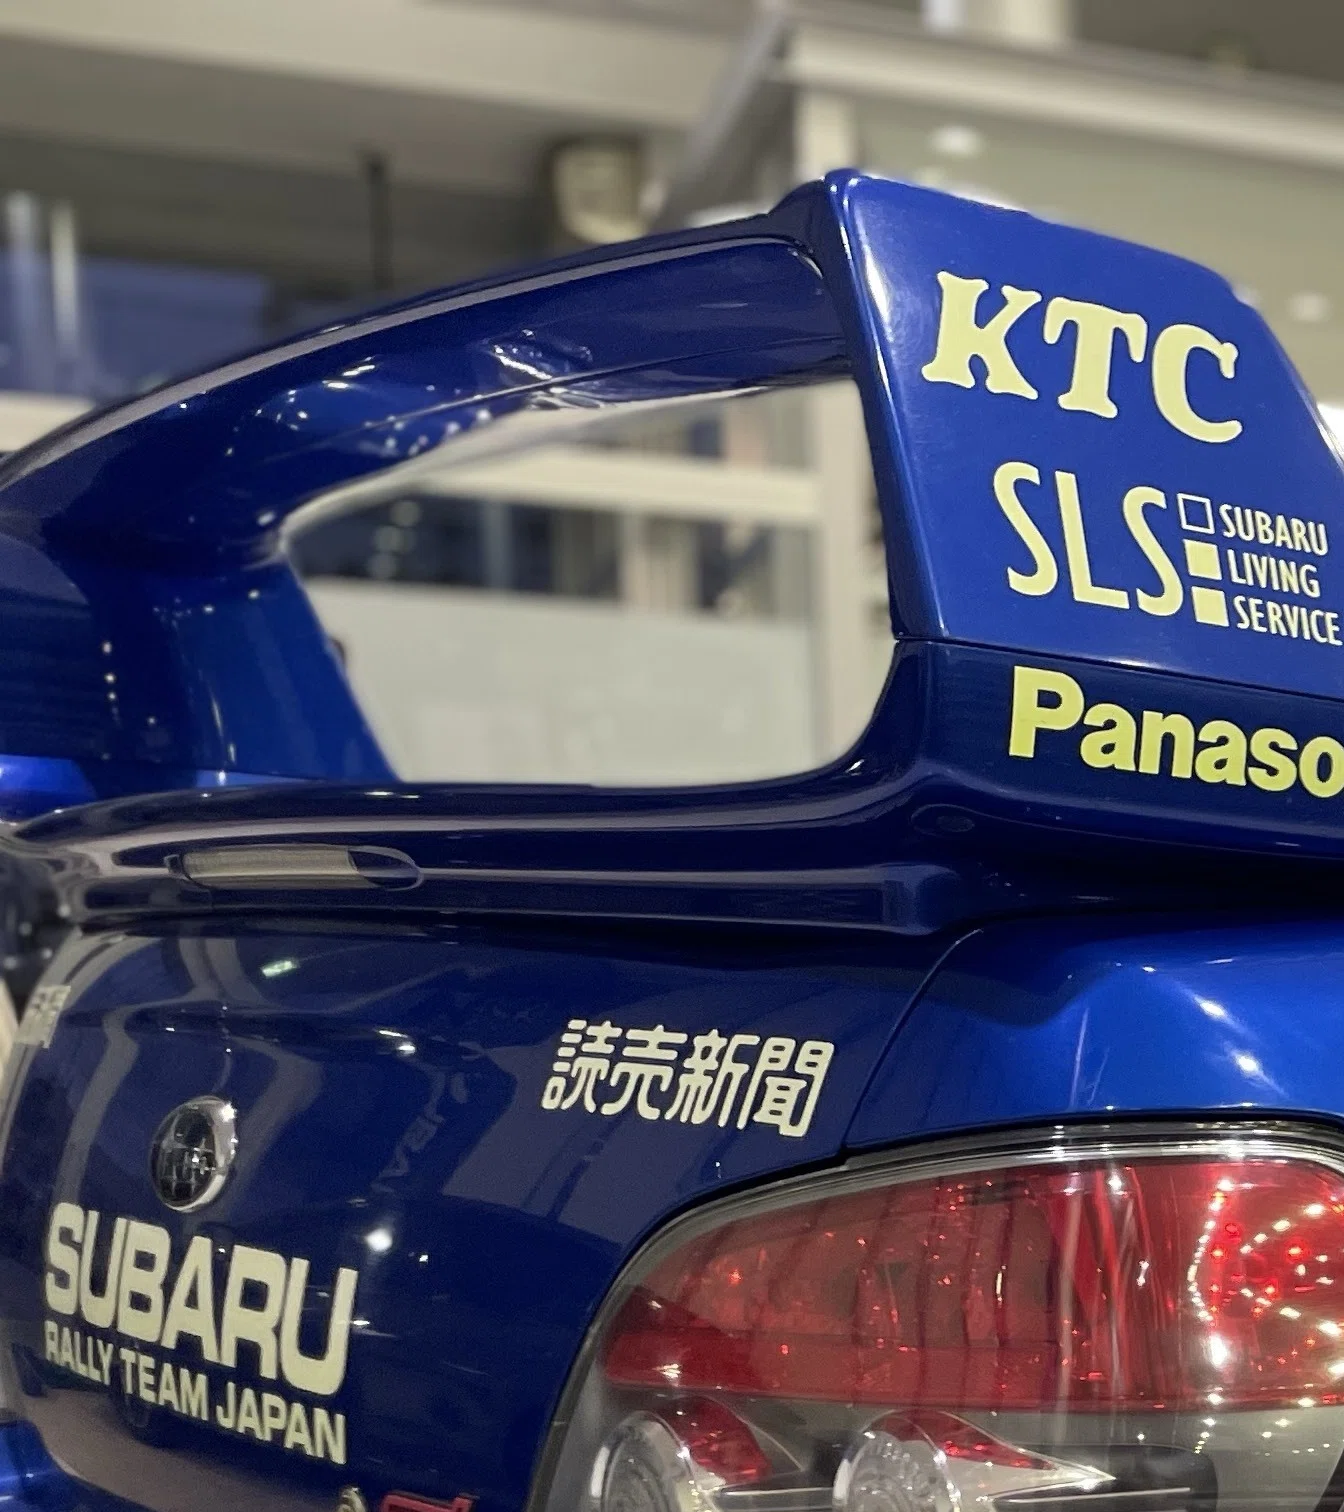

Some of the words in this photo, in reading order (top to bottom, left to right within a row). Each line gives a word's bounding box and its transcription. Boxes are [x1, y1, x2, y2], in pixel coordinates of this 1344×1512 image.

[922, 271, 1243, 442] KTC
[993, 461, 1184, 617] SLS
[1220, 504, 1328, 556] SUBARU
[1227, 550, 1320, 598] LIVING
[1233, 596, 1343, 646] SERVICE
[541, 1019, 835, 1137] 読売新聞
[45, 1202, 358, 1396] SUBARU
[45, 1320, 115, 1386] RALLY
[120, 1348, 208, 1421] TEAM
[216, 1382, 347, 1465] JAPAN
